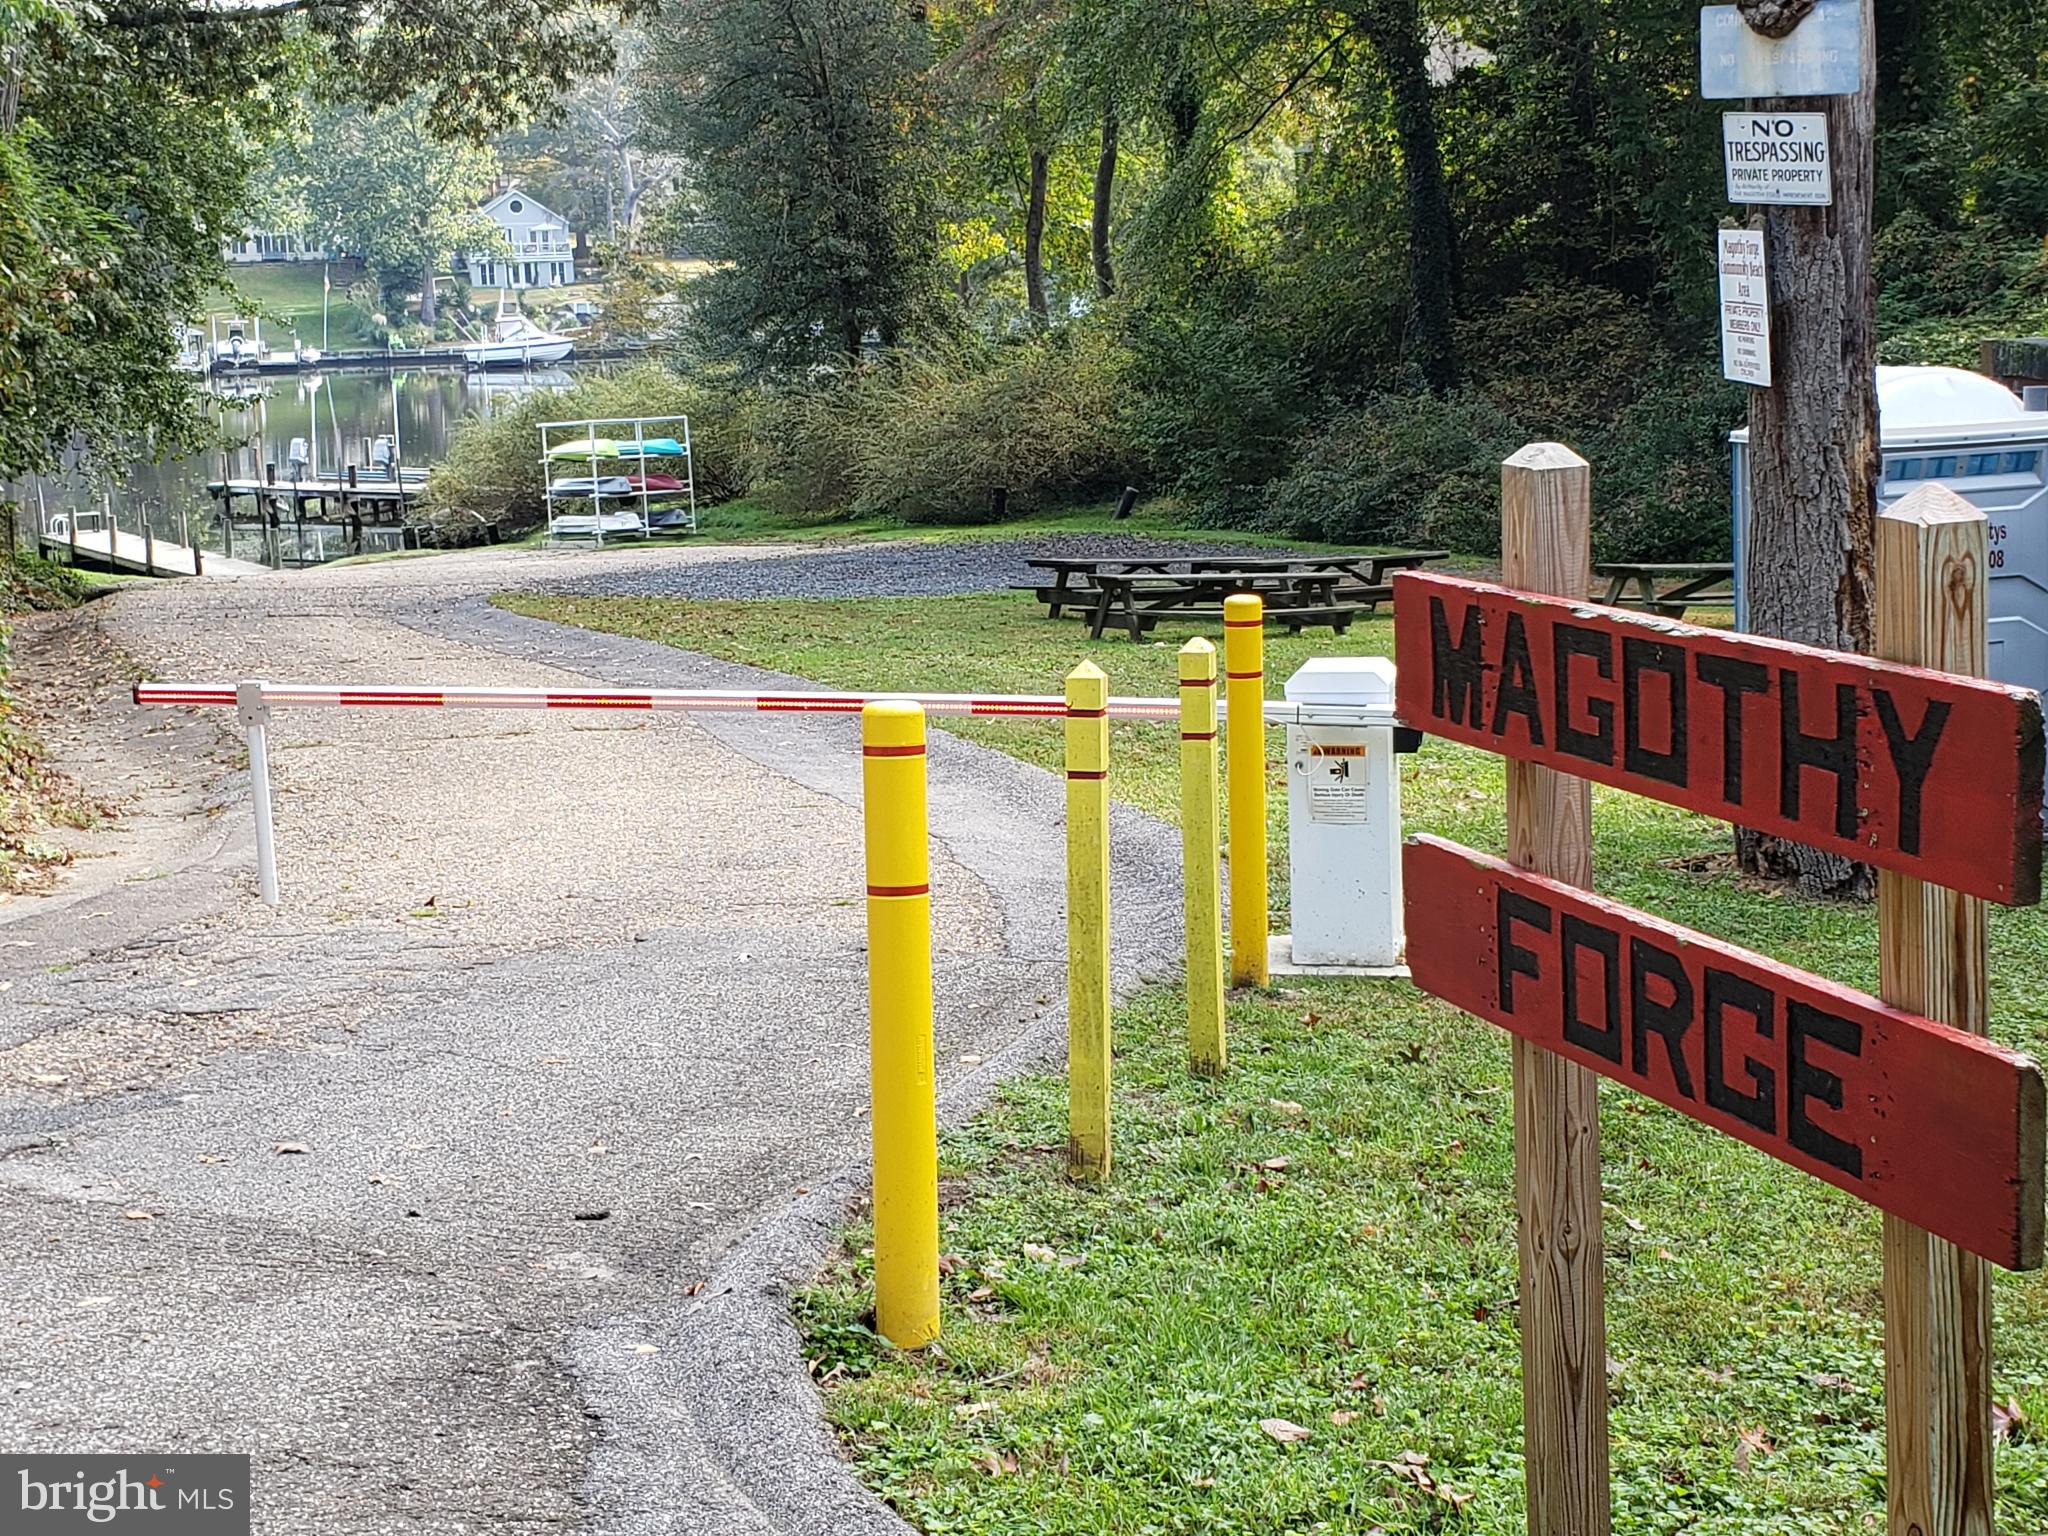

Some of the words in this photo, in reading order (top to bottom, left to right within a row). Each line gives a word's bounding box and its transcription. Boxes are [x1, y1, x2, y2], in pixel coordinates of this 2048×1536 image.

[1752, 119, 1794, 137] NO
[1727, 141, 1825, 162] TRESPASSING
[1732, 168, 1769, 182] PRIVATE
[1772, 168, 1823, 183] PROPERTY
[1427, 595, 1953, 858] MAGOTHY
[1323, 745, 1361, 757] WARNING
[1498, 887, 1864, 1182] FORGE
